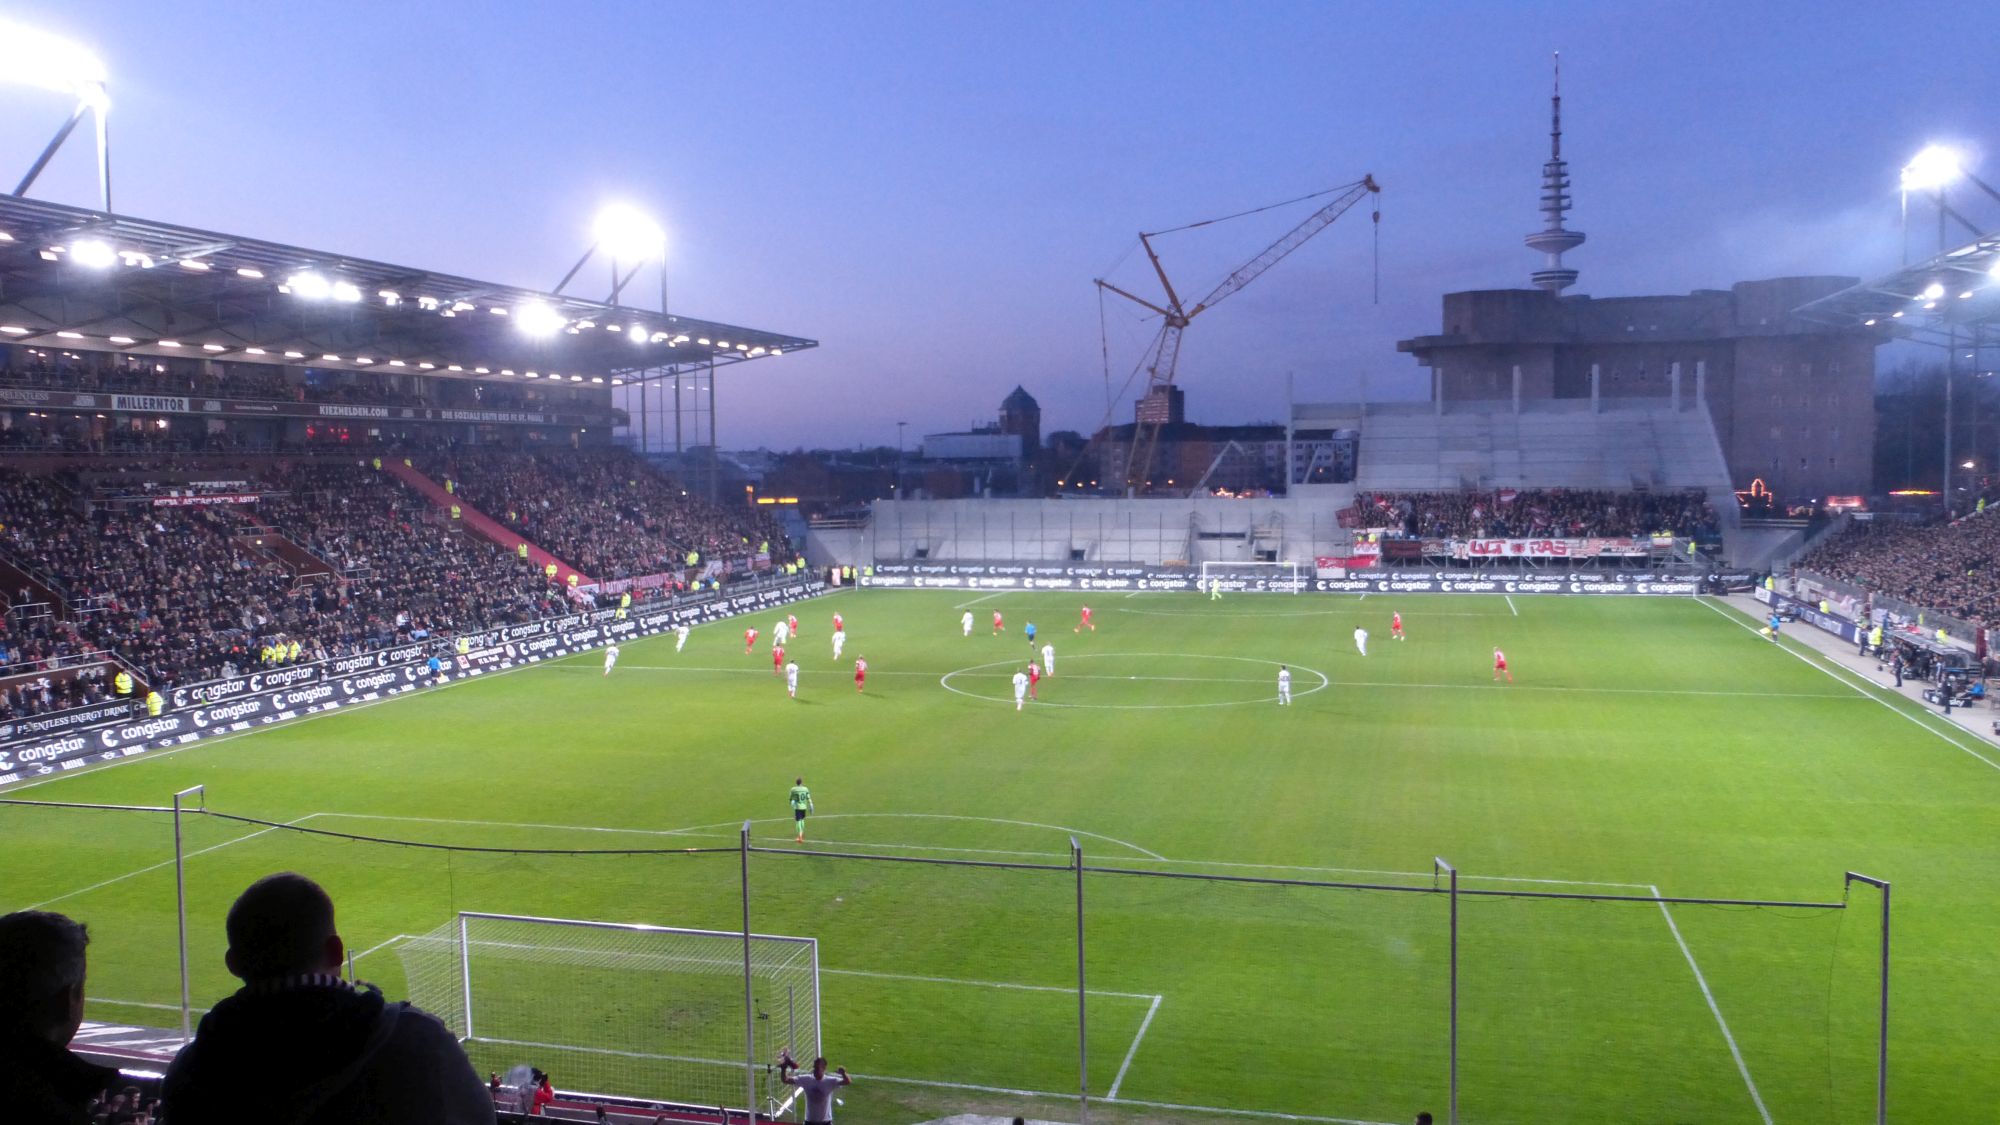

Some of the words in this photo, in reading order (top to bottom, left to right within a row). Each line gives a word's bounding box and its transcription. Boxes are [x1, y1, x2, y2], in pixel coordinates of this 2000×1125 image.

[117, 397, 184, 411] MILLERNTOR
[319, 405, 389, 417] KIEZHELDEN.COM
[1150, 580, 1188, 589] congstar
[1329, 581, 1369, 590] congstar
[1391, 582, 1432, 591] congstar
[1454, 582, 1496, 592] congstar
[1518, 583, 1560, 592] congstar
[1584, 583, 1627, 592] congstar
[1650, 584, 1694, 593] congstar
[511, 623, 541, 637] congstar
[571, 629, 598, 642] congstar
[529, 637, 557, 651] congstar
[336, 655, 374, 672] ongstar
[266, 667, 313, 686] congstar
[356, 672, 396, 689] congstar
[287, 685, 333, 703] congstar
[70, 709, 103, 724] ENERGY
[104, 704, 130, 717] DRINK
[210, 701, 260, 720] congstar
[121, 718, 180, 739] congstar
[178, 732, 200, 743] MINI
[18, 737, 85, 761] congstar
[121, 744, 145, 756] MINI
[61, 758, 86, 770] MINI
